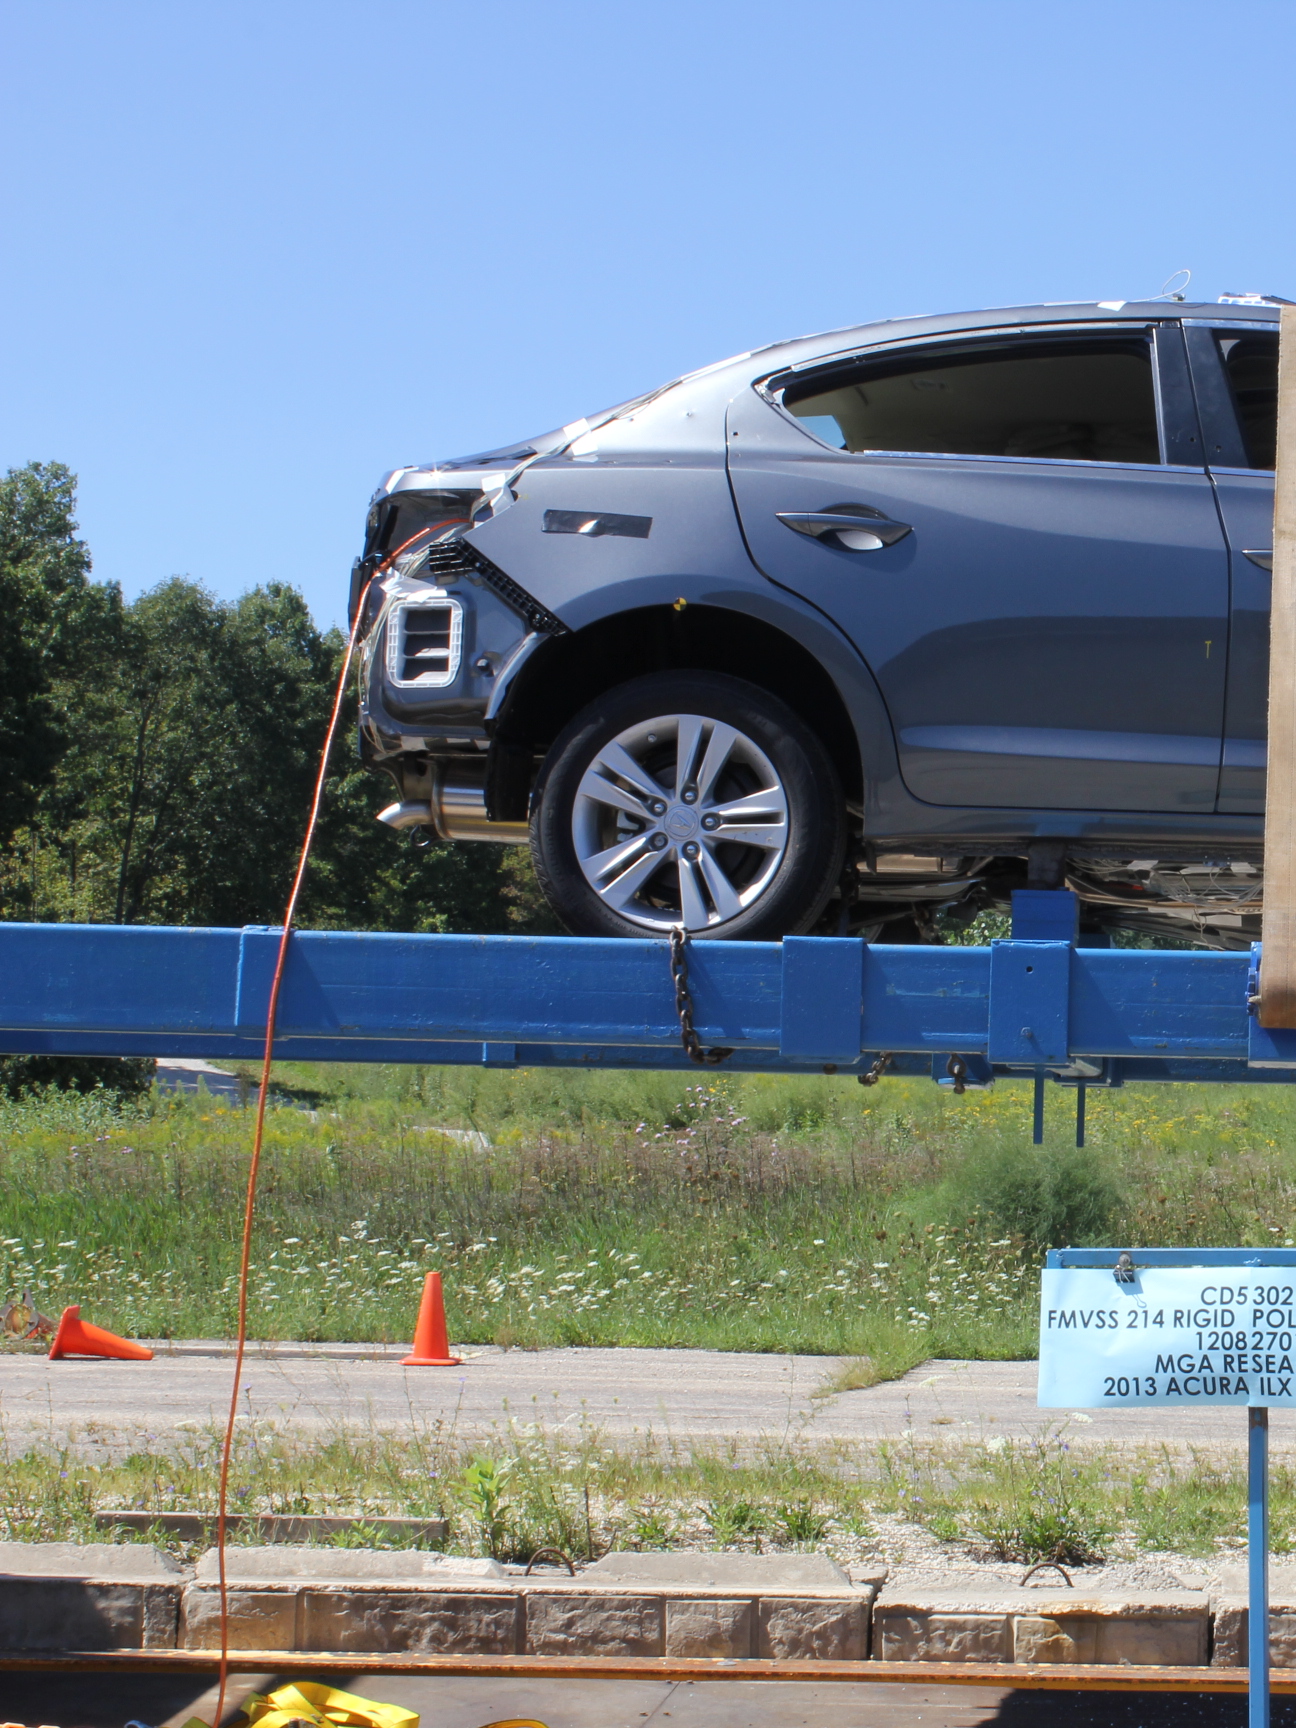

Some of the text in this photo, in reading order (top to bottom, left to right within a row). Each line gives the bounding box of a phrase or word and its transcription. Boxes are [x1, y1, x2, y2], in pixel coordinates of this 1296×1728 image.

[1048, 1310, 1118, 1329] FMVSS
[1127, 1309, 1164, 1328] 214
[1173, 1309, 1235, 1328] RIGID
[1154, 1353, 1215, 1374] MGA
[1103, 1376, 1158, 1397] 2013
[1165, 1375, 1250, 1397] ACURA
[1259, 1376, 1293, 1397] ILX
